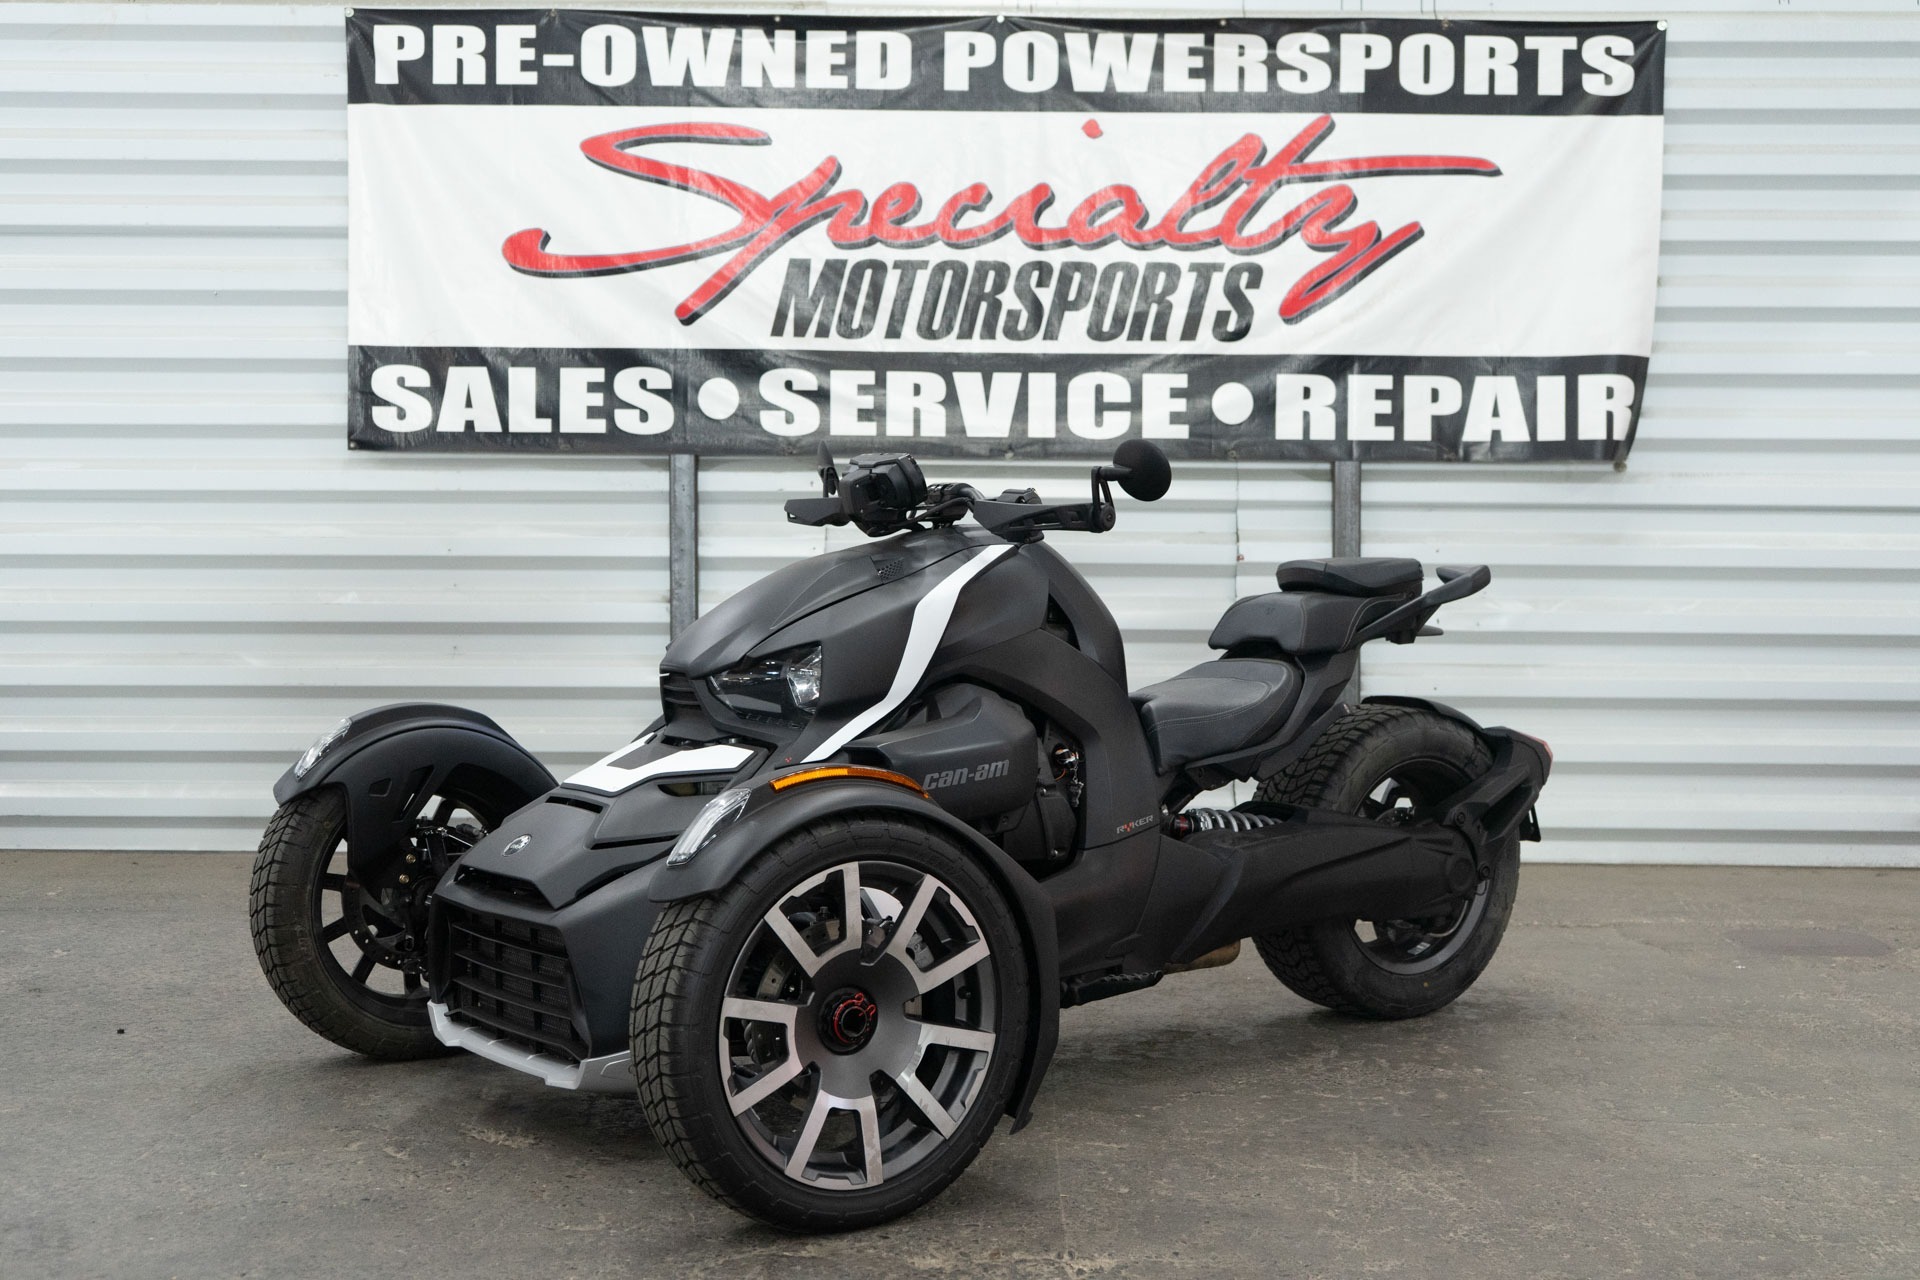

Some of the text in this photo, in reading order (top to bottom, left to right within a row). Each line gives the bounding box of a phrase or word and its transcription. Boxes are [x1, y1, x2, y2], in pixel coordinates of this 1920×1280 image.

[372, 24, 1636, 97] PRE-OWNED POWERSPORTS
[501, 113, 1504, 326] Specialty
[770, 257, 1264, 343] MOTORSPORTS
[370, 364, 1636, 443] SALES SERVICE REPAIR
[923, 758, 1010, 791] can-am
[1116, 814, 1154, 834] RYKER
